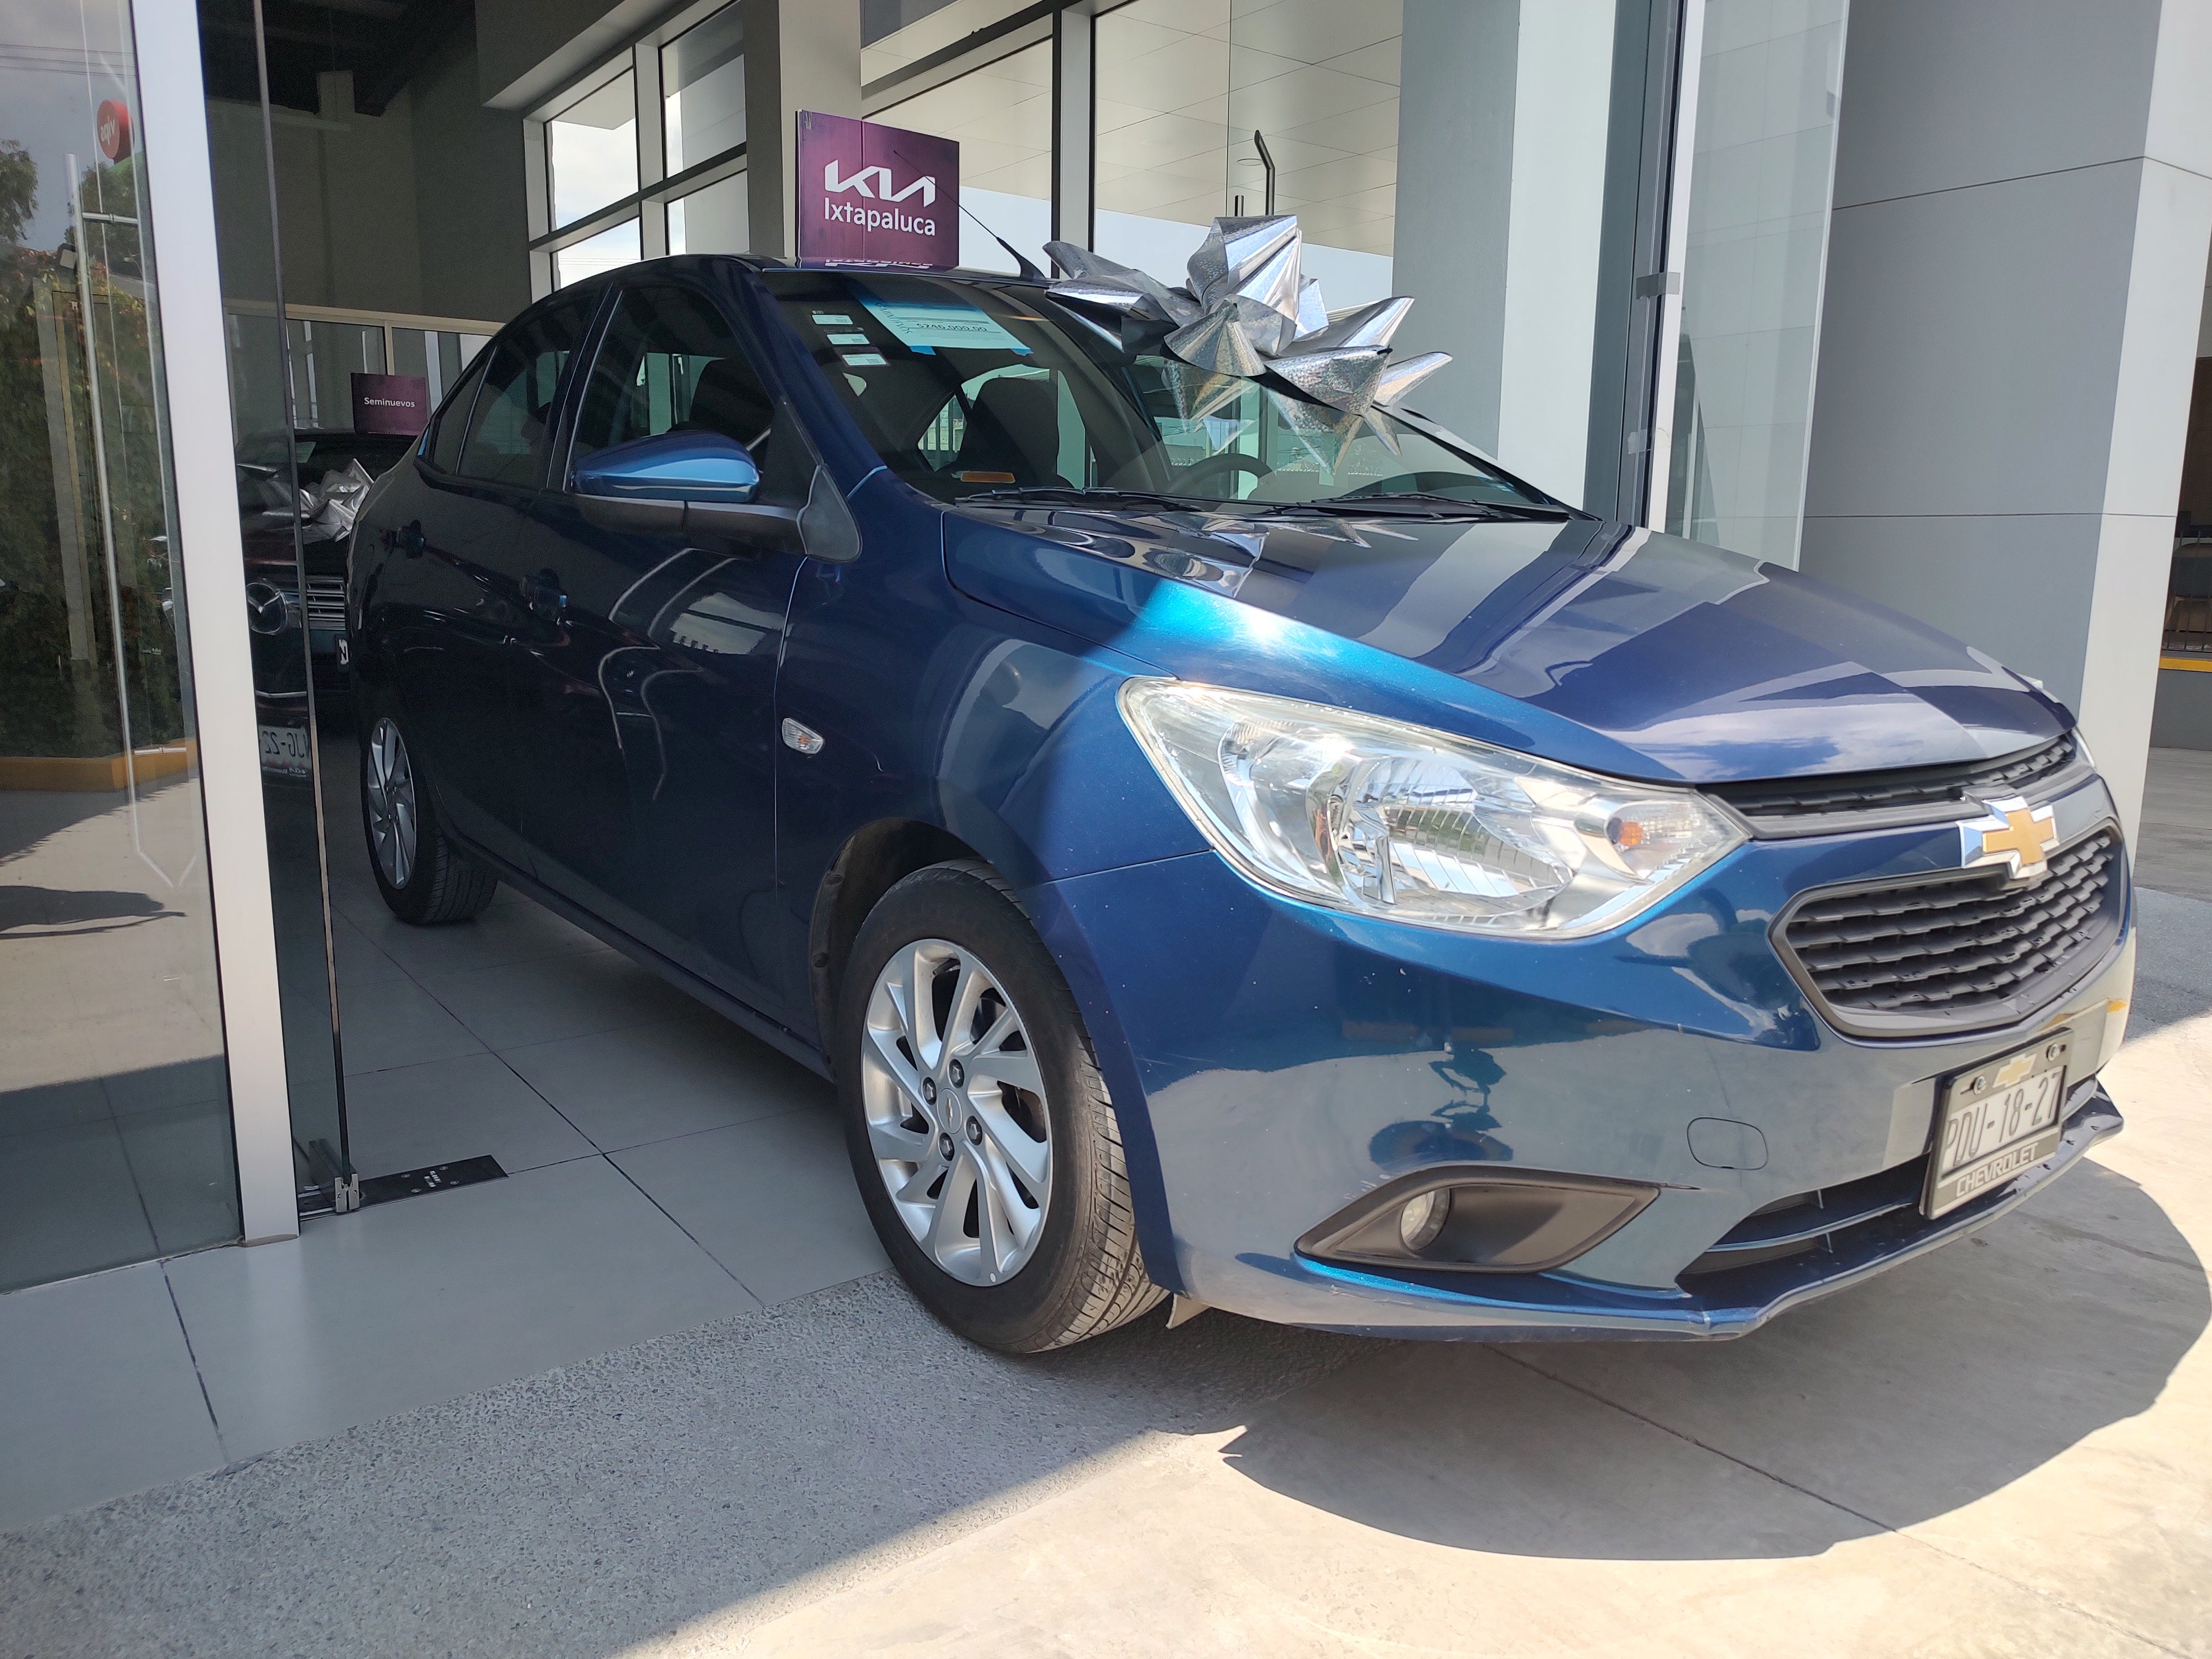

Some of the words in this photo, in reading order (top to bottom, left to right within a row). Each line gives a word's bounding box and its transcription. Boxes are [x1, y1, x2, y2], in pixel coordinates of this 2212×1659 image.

[825, 159, 936, 208] KIA
[825, 197, 935, 236] Ixtapaluca
[364, 397, 415, 408] Seminuevos
[1956, 1142, 2038, 1197] CHEVROLET
